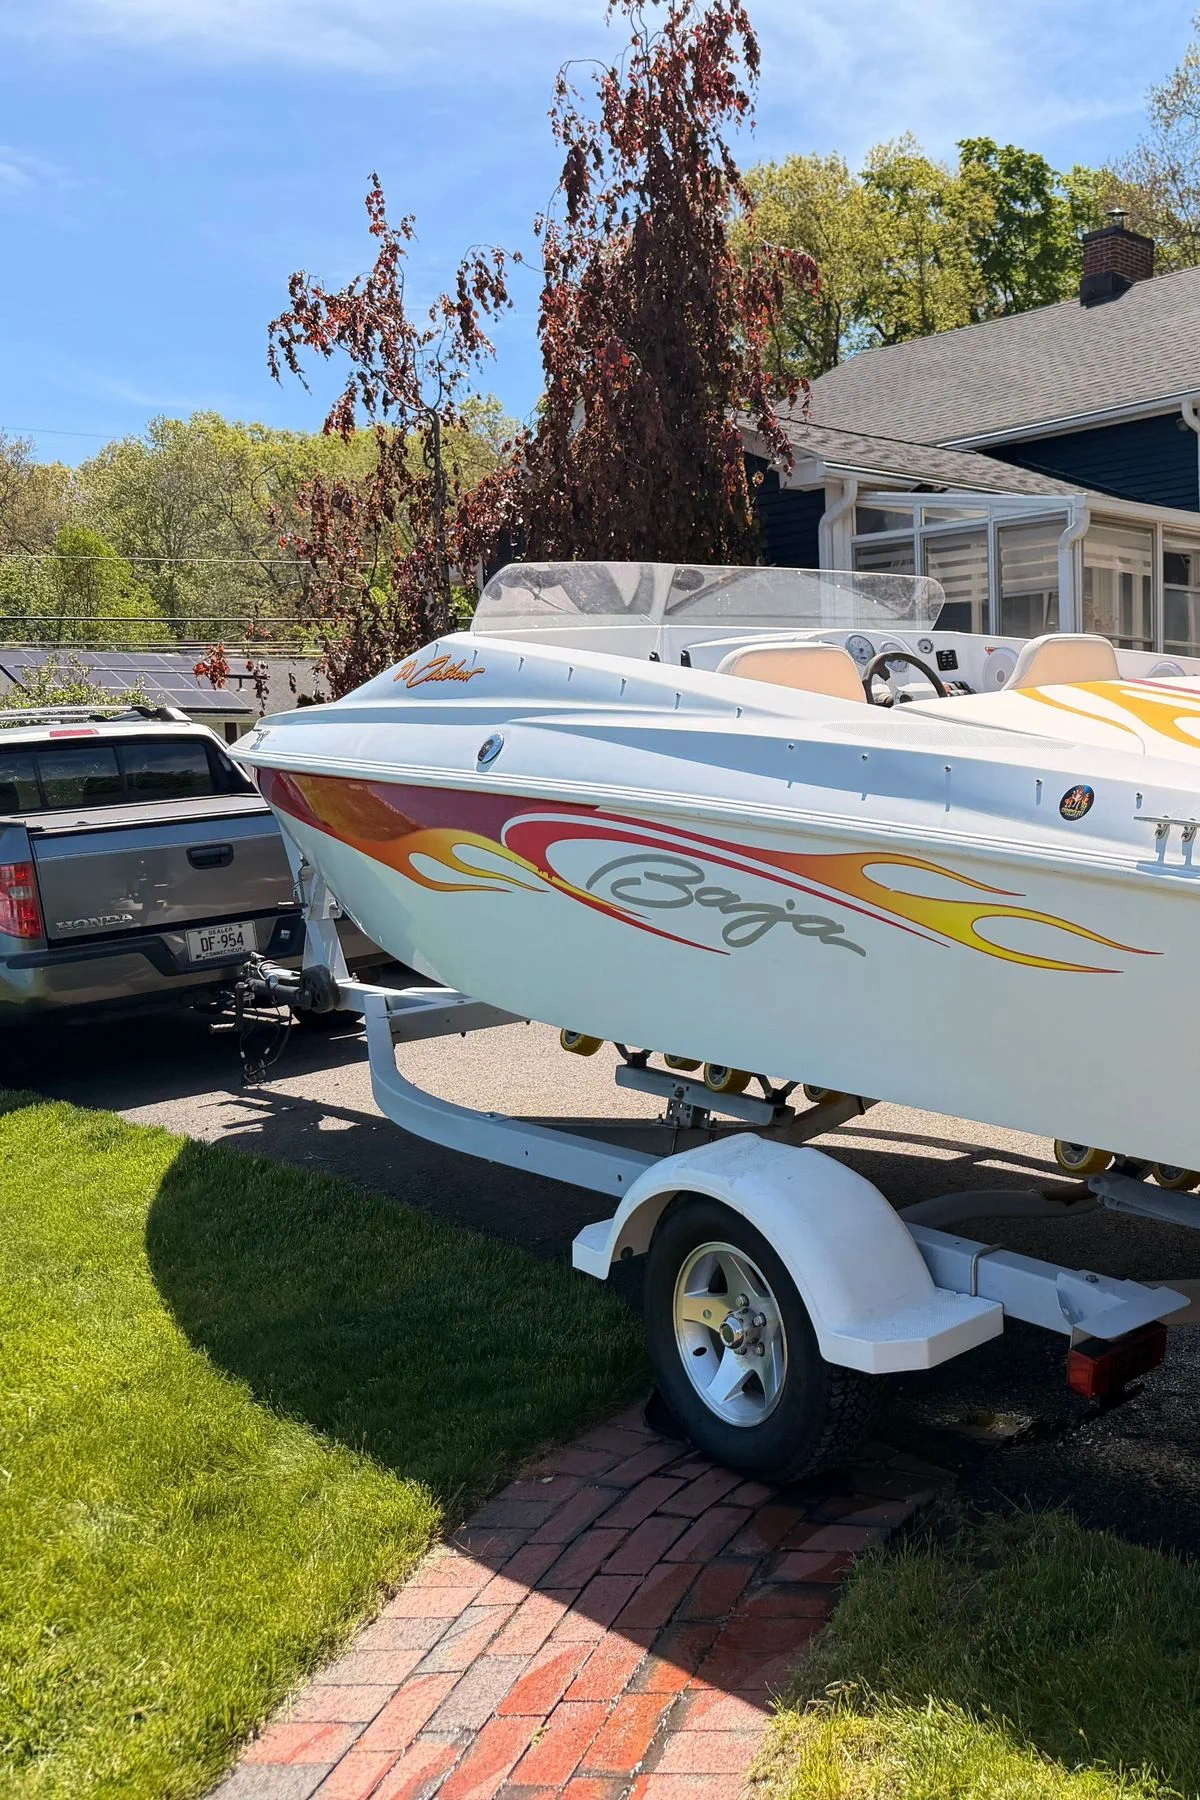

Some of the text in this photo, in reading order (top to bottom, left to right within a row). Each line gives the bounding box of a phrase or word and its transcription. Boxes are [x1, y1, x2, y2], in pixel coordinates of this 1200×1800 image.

[585, 853, 867, 958] Baja
[55, 912, 135, 931] HONDA
[208, 927, 233, 936] DEALER
[205, 947, 242, 957] CONNECTICUT
